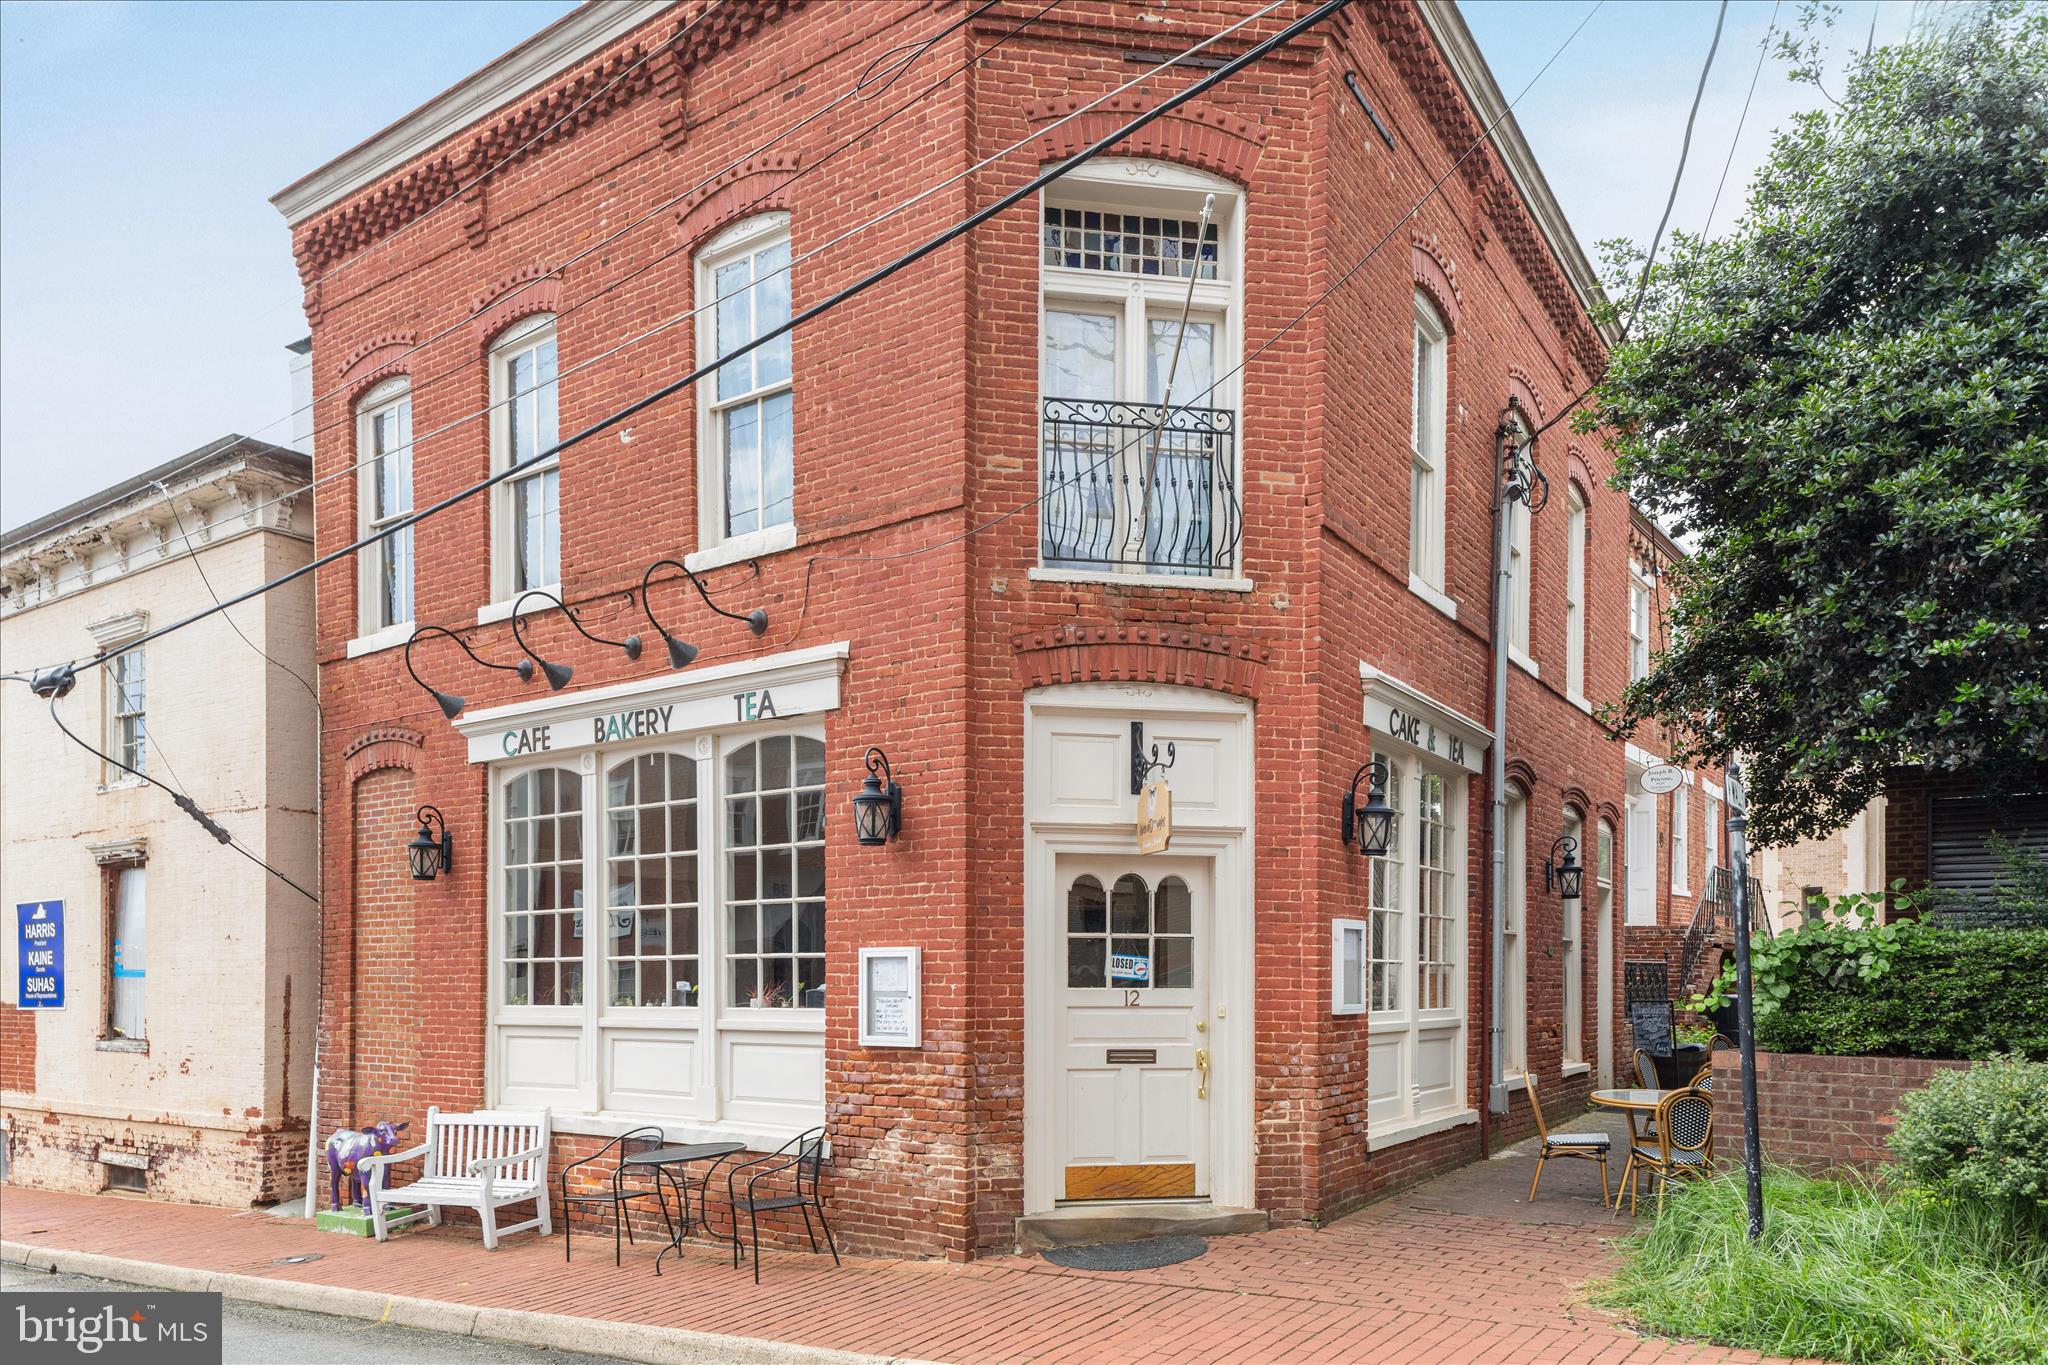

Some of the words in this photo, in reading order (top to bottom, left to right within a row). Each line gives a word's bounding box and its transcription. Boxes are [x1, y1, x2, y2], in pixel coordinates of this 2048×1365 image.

[502, 725, 551, 757] CAFE
[593, 705, 673, 744] BAKERY
[733, 689, 777, 721] TEA
[1389, 708, 1421, 746] CAKE
[1427, 724, 1436, 752] &
[1448, 735, 1465, 766] TEA
[25, 922, 56, 939] HARRIS
[28, 950, 54, 966] KAINE
[1111, 957, 1134, 970] LOSED
[27, 976, 55, 992] SUHAS
[1124, 990, 1140, 1007] 12
